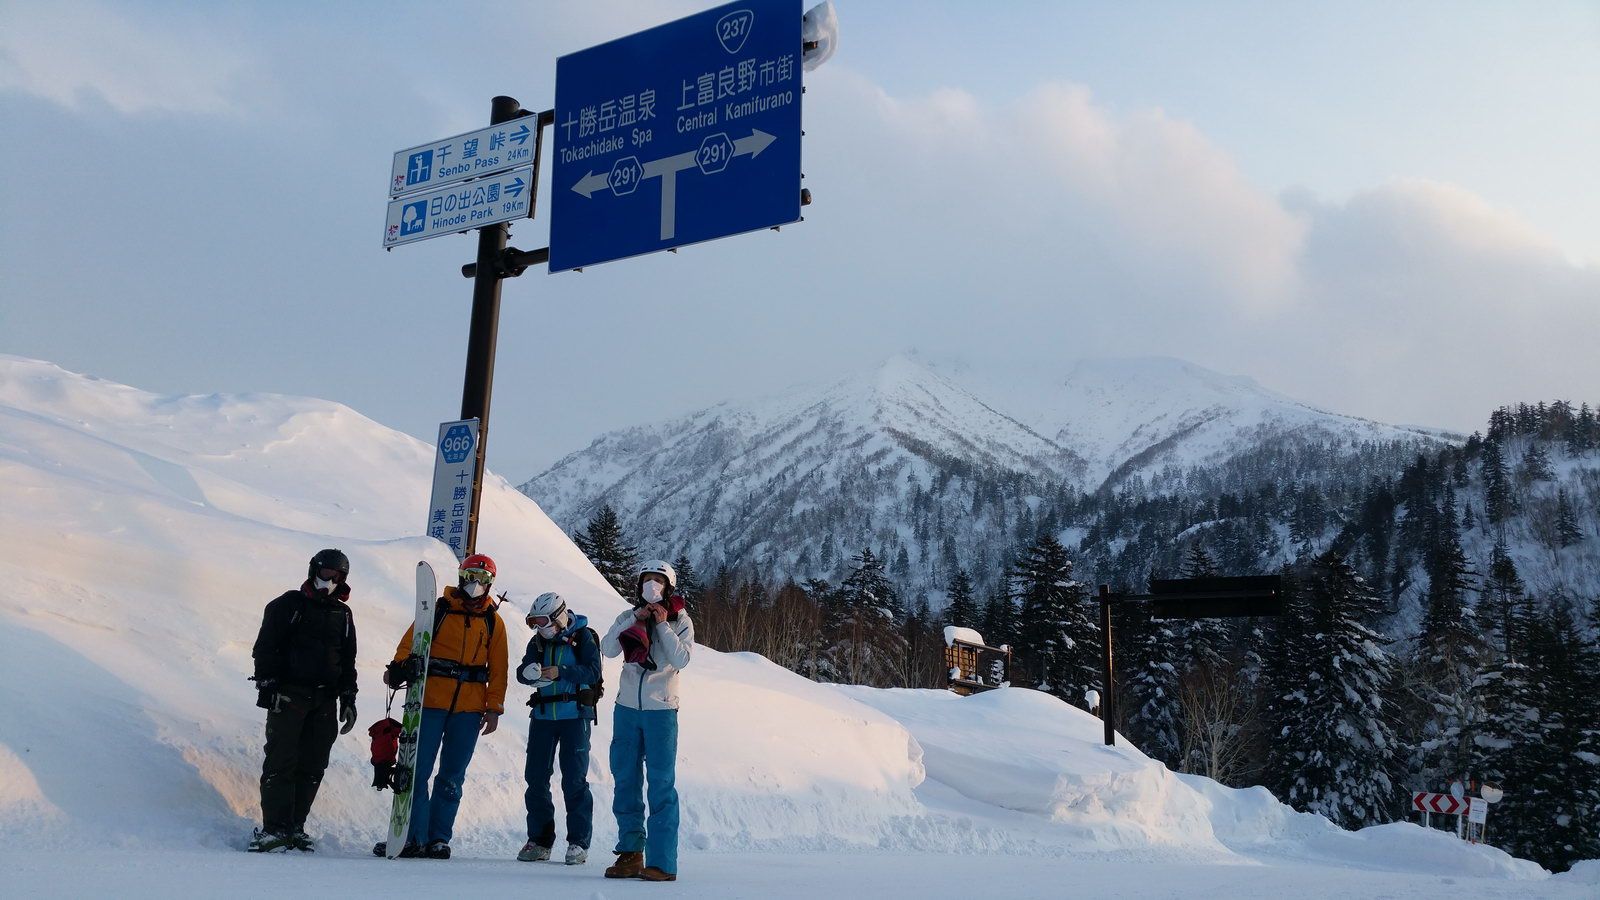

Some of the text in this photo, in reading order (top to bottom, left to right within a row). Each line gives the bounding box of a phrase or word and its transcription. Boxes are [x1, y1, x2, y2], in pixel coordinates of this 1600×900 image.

[722, 16, 748, 40] 237
[676, 54, 794, 111] 上富良野市街
[561, 88, 656, 141] 十勝岳温泉
[677, 90, 793, 133] Central Kamifurano
[560, 128, 652, 164] Tokachidake Spa
[702, 142, 726, 165] 291
[438, 164, 470, 178] Senbo
[474, 156, 499, 169] Pass
[614, 165, 637, 187] 291
[431, 182, 501, 216] 日の出公園
[432, 201, 524, 229] Hinode Park 19Km
[443, 435, 470, 453] 966
[448, 469, 469, 550] 十勝岳温泉
